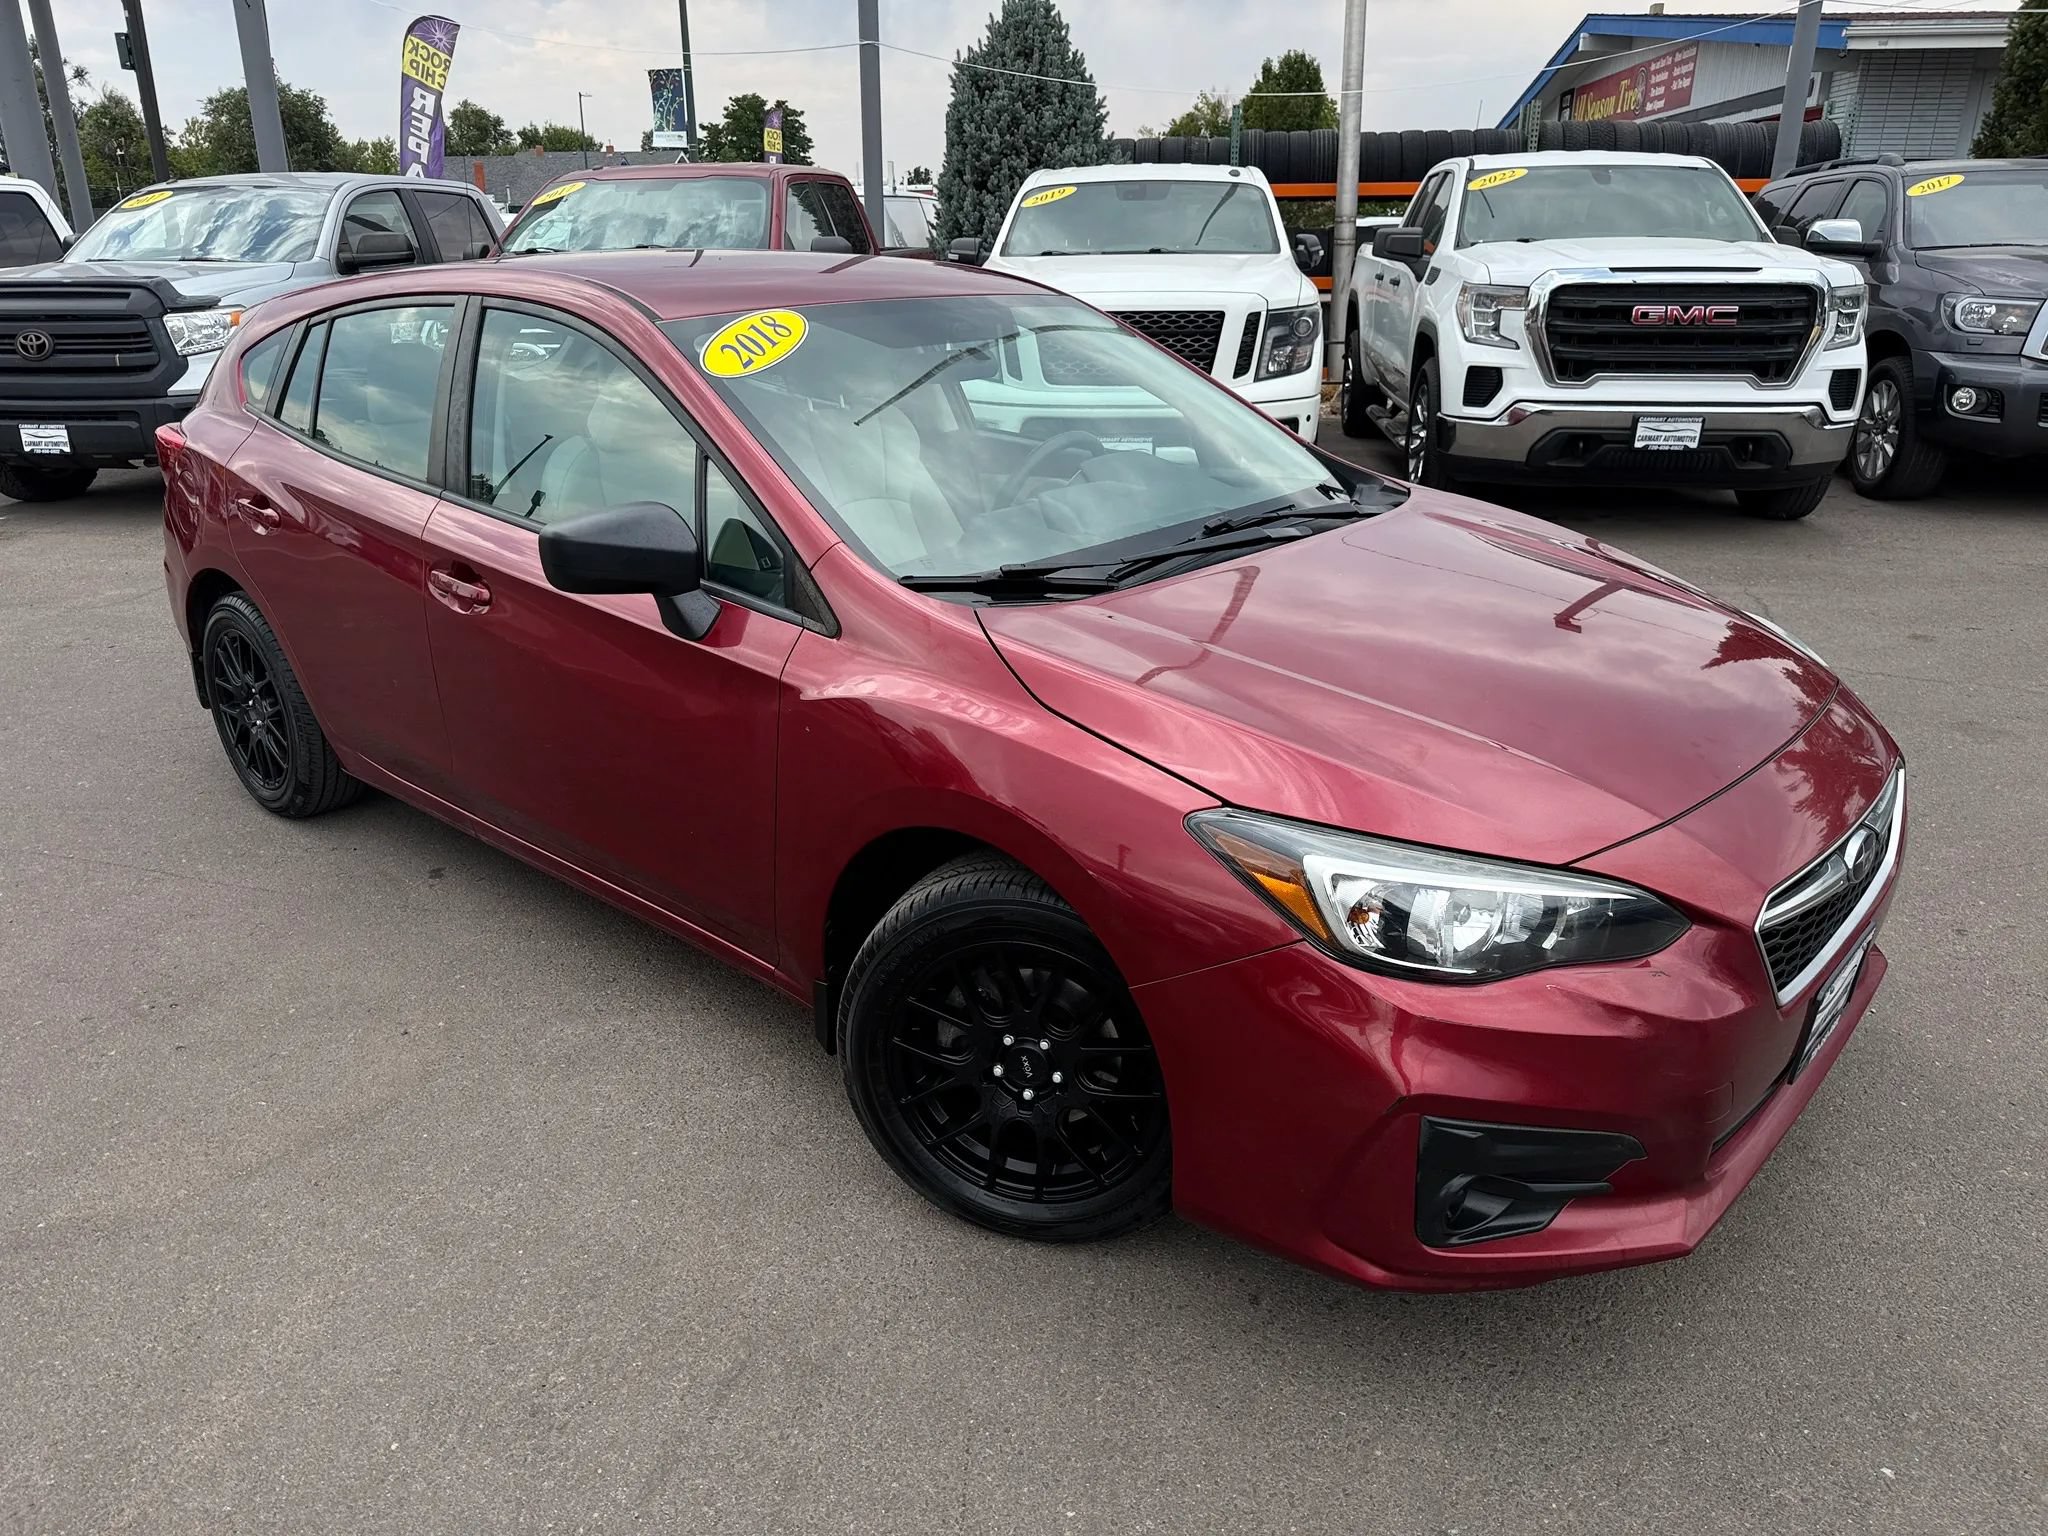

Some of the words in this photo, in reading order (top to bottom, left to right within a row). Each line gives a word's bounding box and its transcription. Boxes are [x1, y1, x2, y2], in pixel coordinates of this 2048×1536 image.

[1574, 94, 1587, 121] All
[1585, 92, 1616, 121] Season
[1616, 79, 1639, 114] Tire
[1479, 170, 1517, 188] 2022
[1917, 175, 1951, 194] 2017
[1031, 188, 1066, 205] 2019
[1630, 305, 1739, 325] GMC
[720, 315, 792, 370] 2018
[43, 440, 69, 448] AUTOMOTIVE
[1636, 434, 1663, 443] CARMART
[1662, 434, 1698, 443] AUTOMOTIVE
[1014, 1055, 1033, 1079] VOXX
